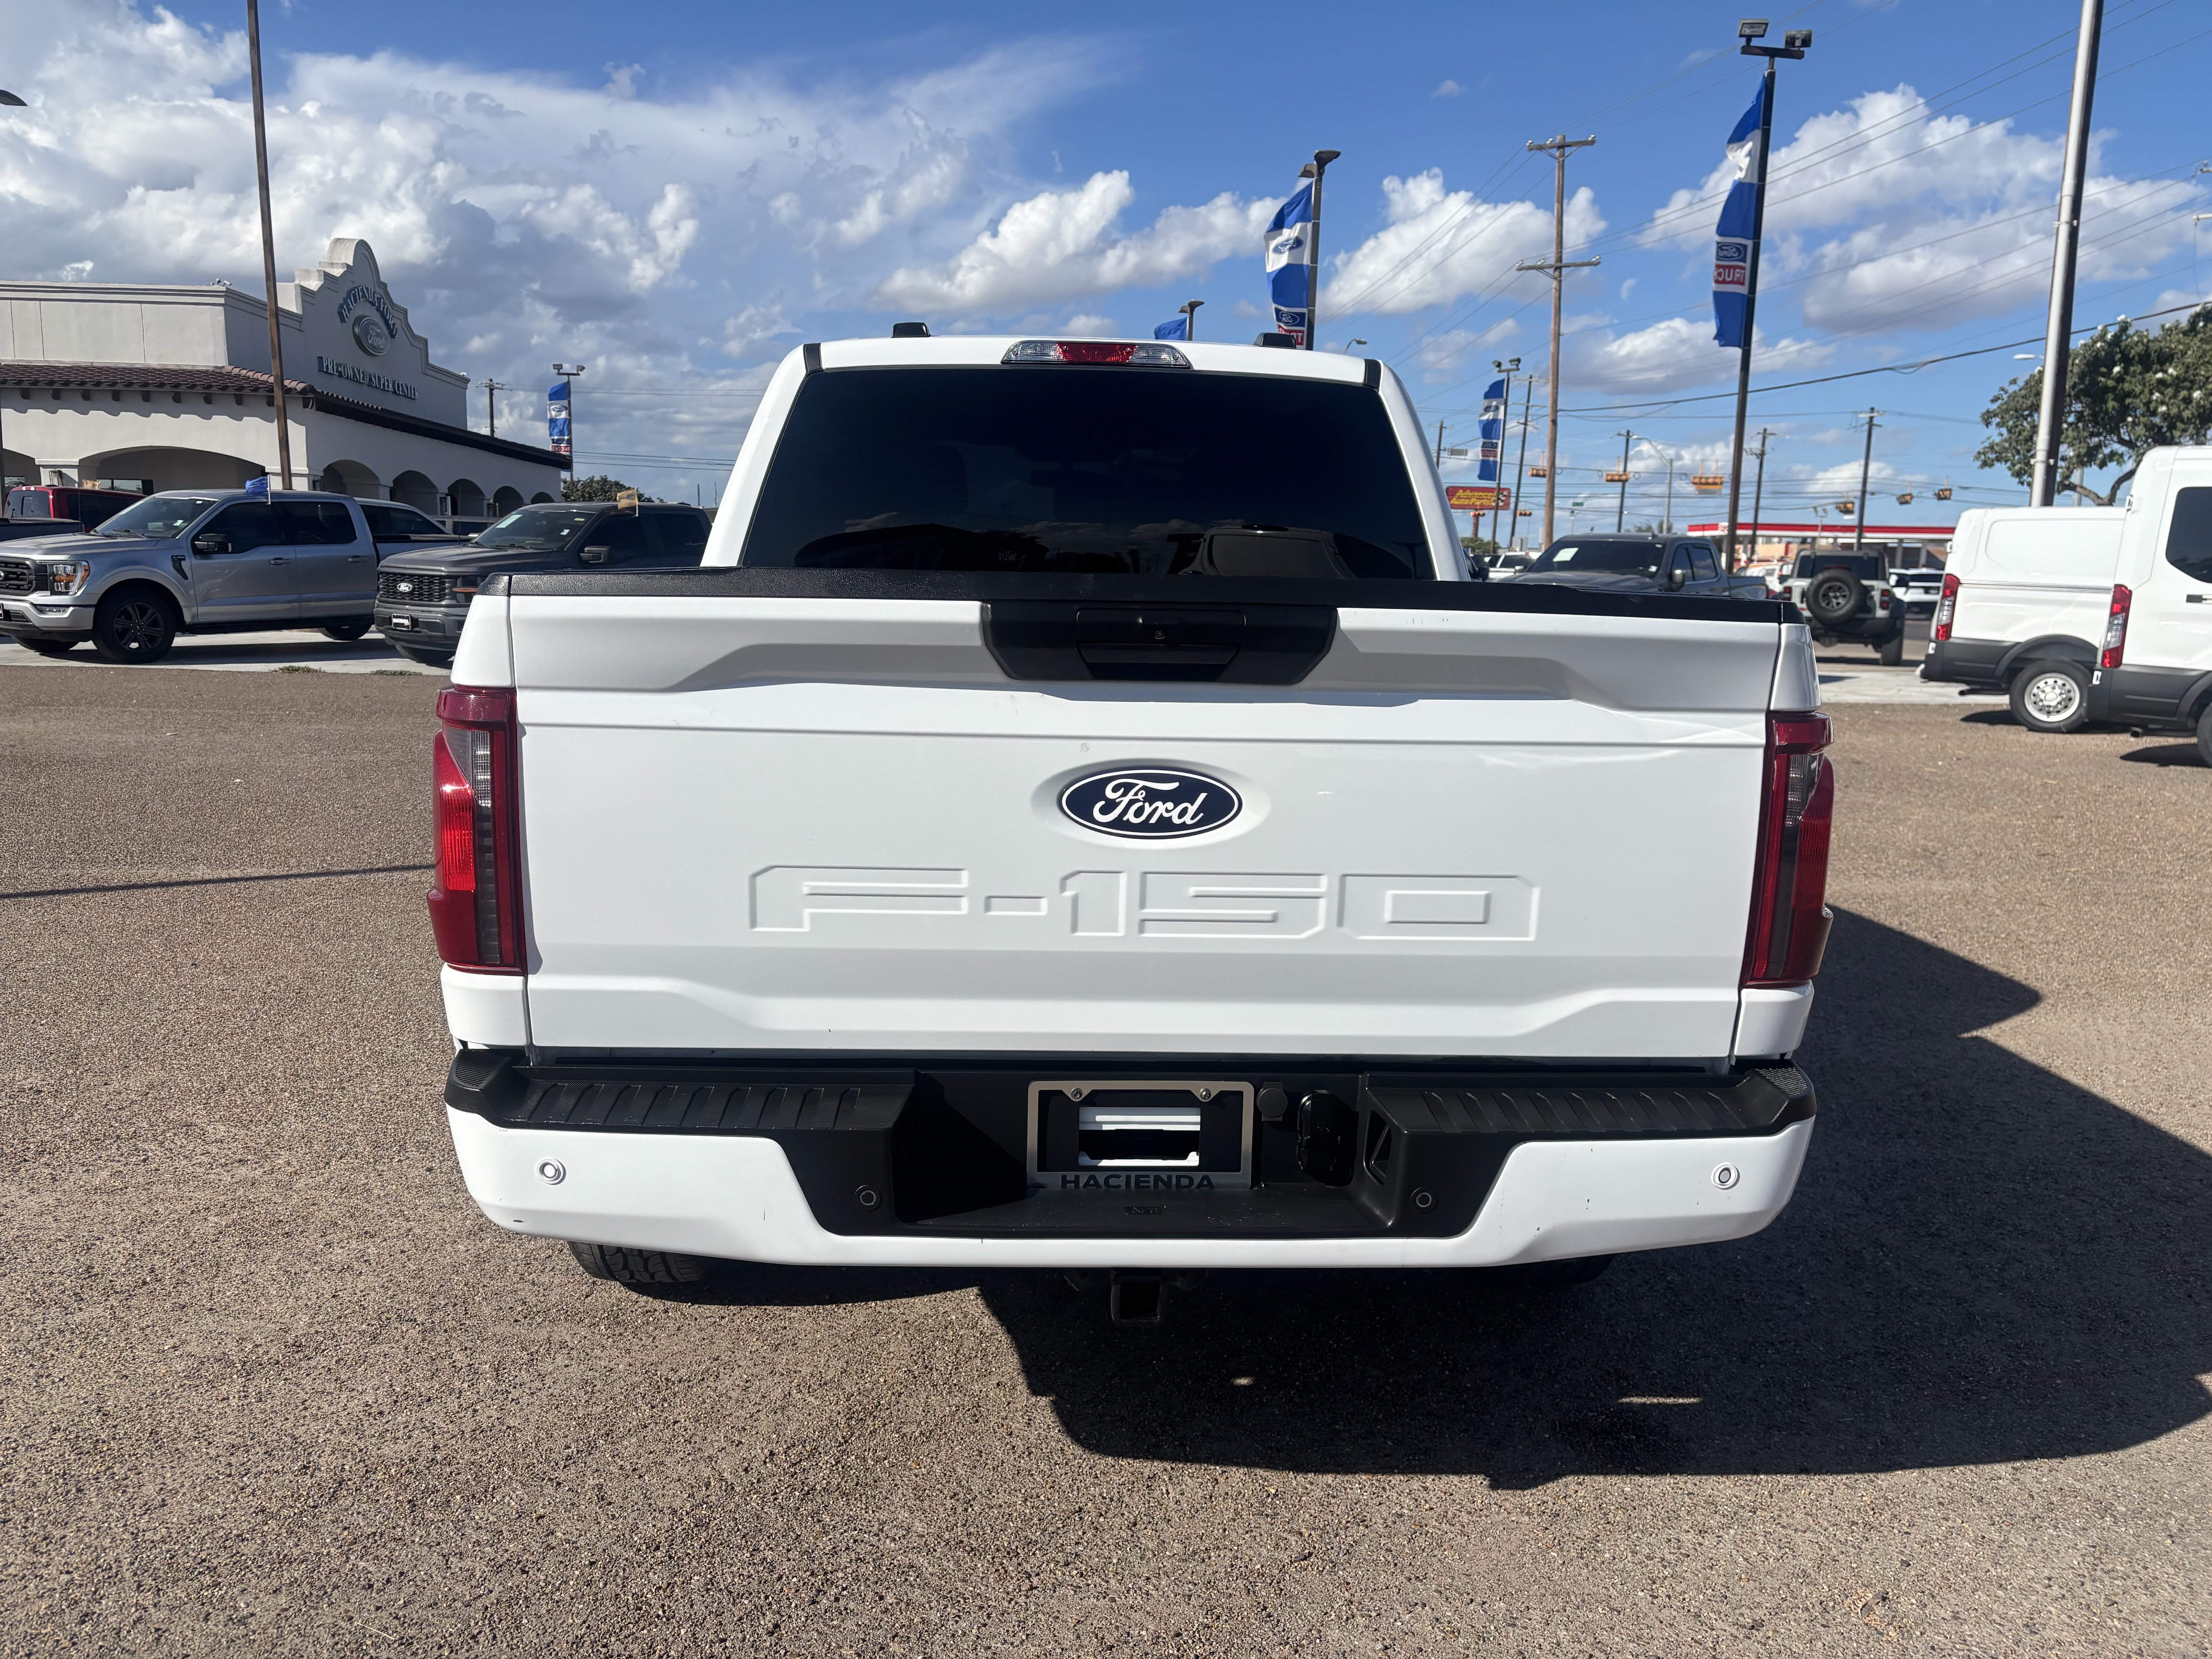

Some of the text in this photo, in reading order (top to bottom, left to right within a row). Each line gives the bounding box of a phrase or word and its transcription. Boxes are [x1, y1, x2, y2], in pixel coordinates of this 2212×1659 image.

[341, 285, 398, 338] HACIENDA FORD
[368, 325, 388, 349] Ford
[323, 357, 418, 399] PRE-OWNED SUPER CENTER
[1093, 778, 1208, 824] Ford
[750, 865, 1540, 941] F-150
[1061, 1174, 1216, 1189] HACIENDA
